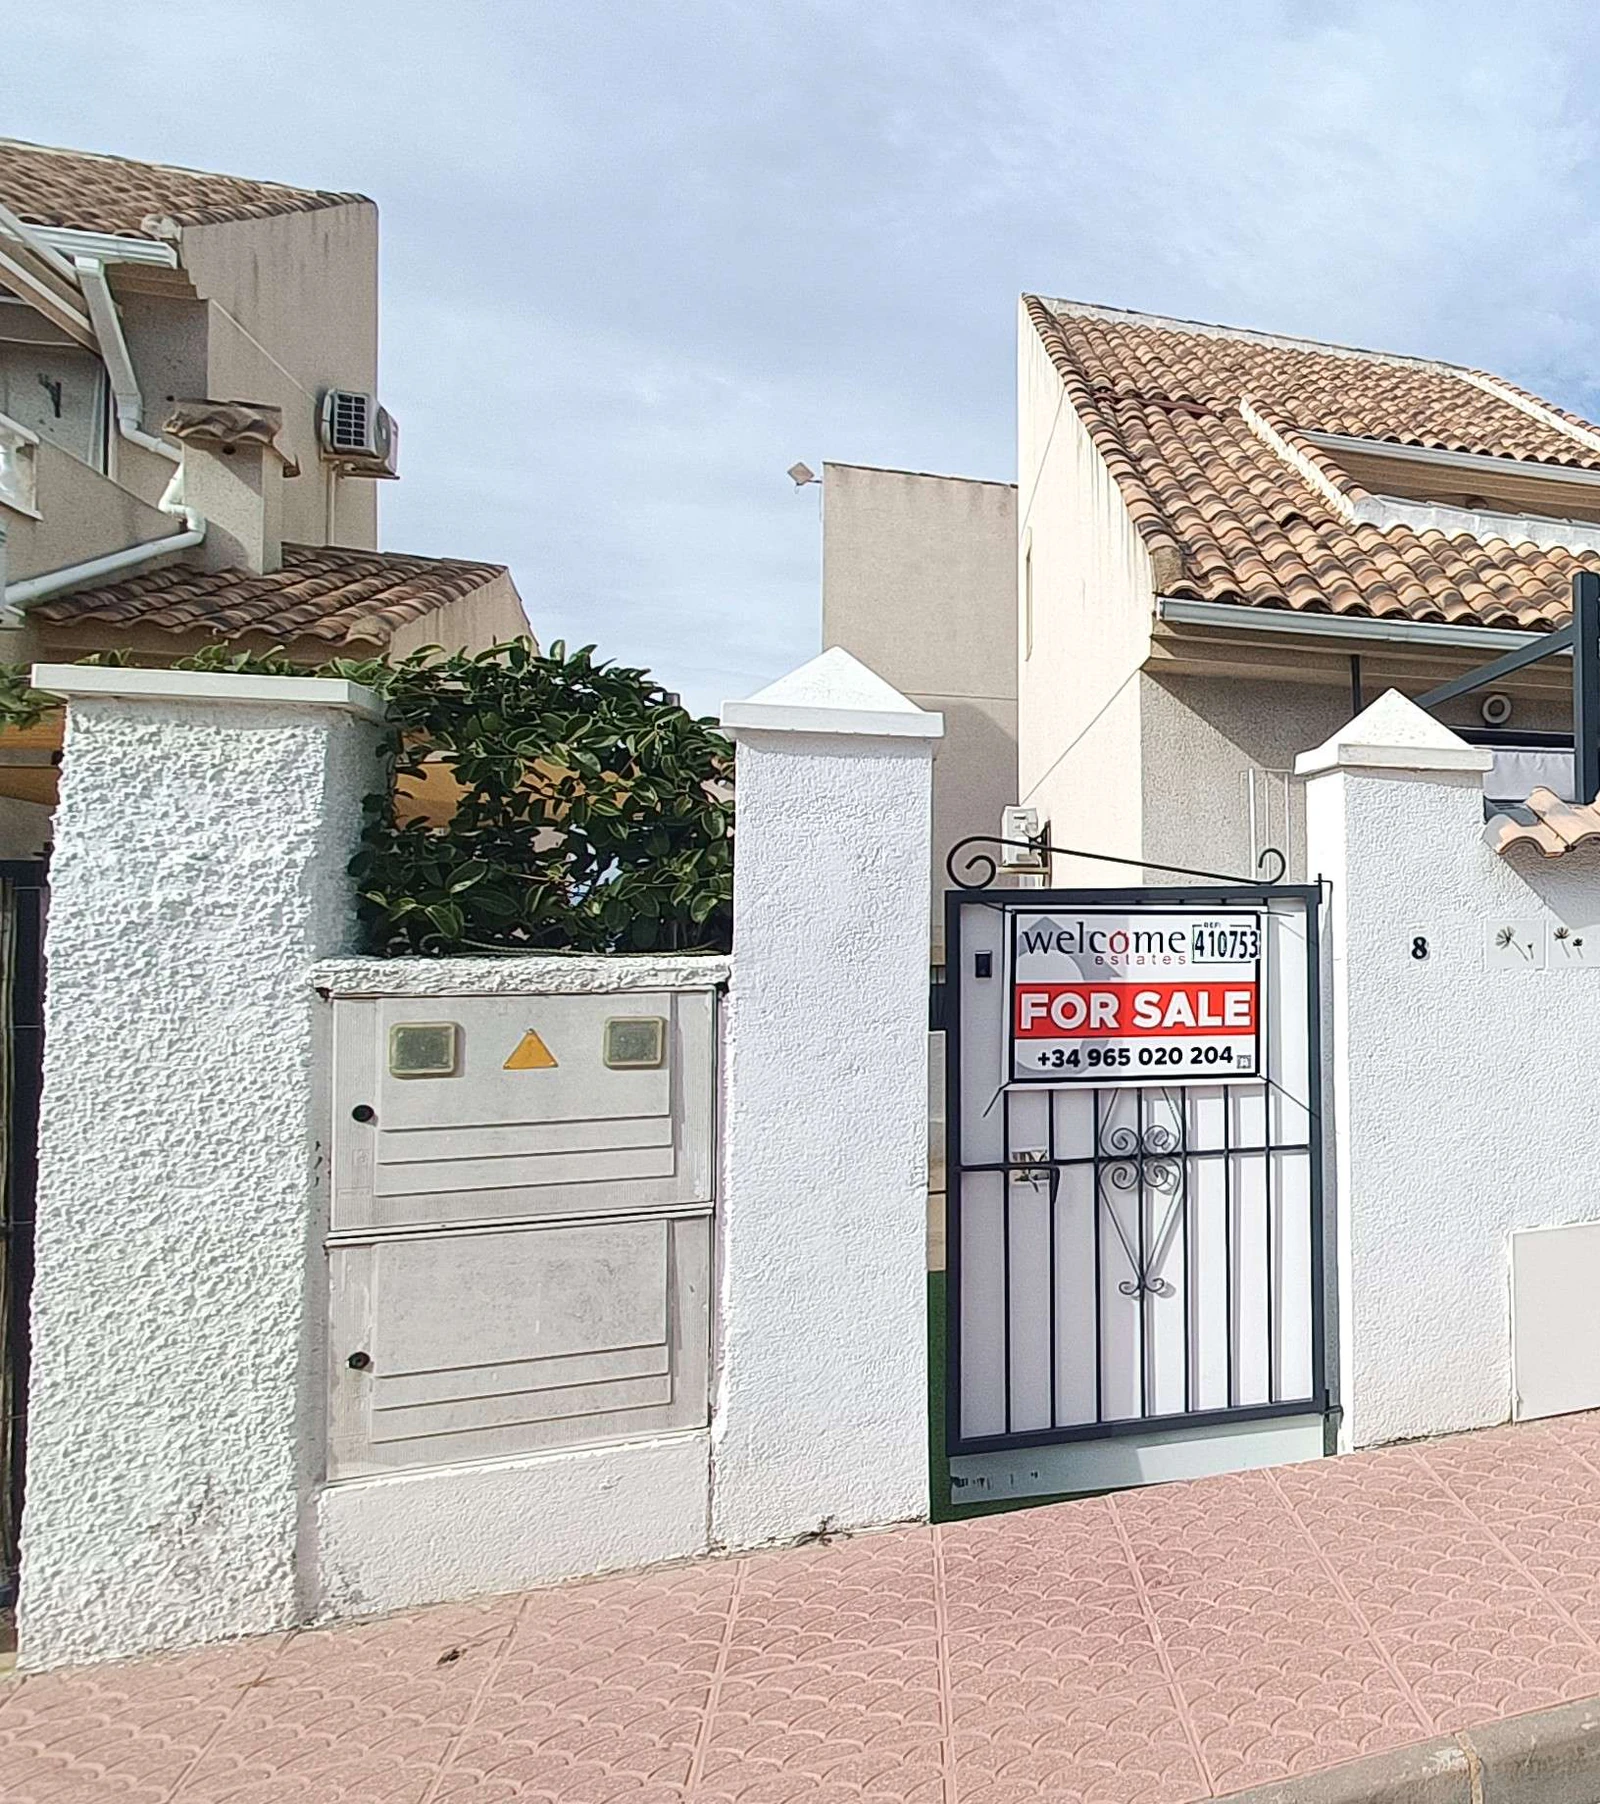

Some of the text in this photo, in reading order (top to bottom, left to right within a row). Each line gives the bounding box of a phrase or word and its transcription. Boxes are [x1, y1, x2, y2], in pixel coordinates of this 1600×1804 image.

[1022, 922, 1186, 955] welcome
[1194, 930, 1258, 959] 410753
[1412, 936, 1428, 960] 8
[1095, 953, 1186, 965] estates
[1020, 991, 1251, 1030] FOR SALE
[1037, 1046, 1233, 1068] +34 965 020 204
